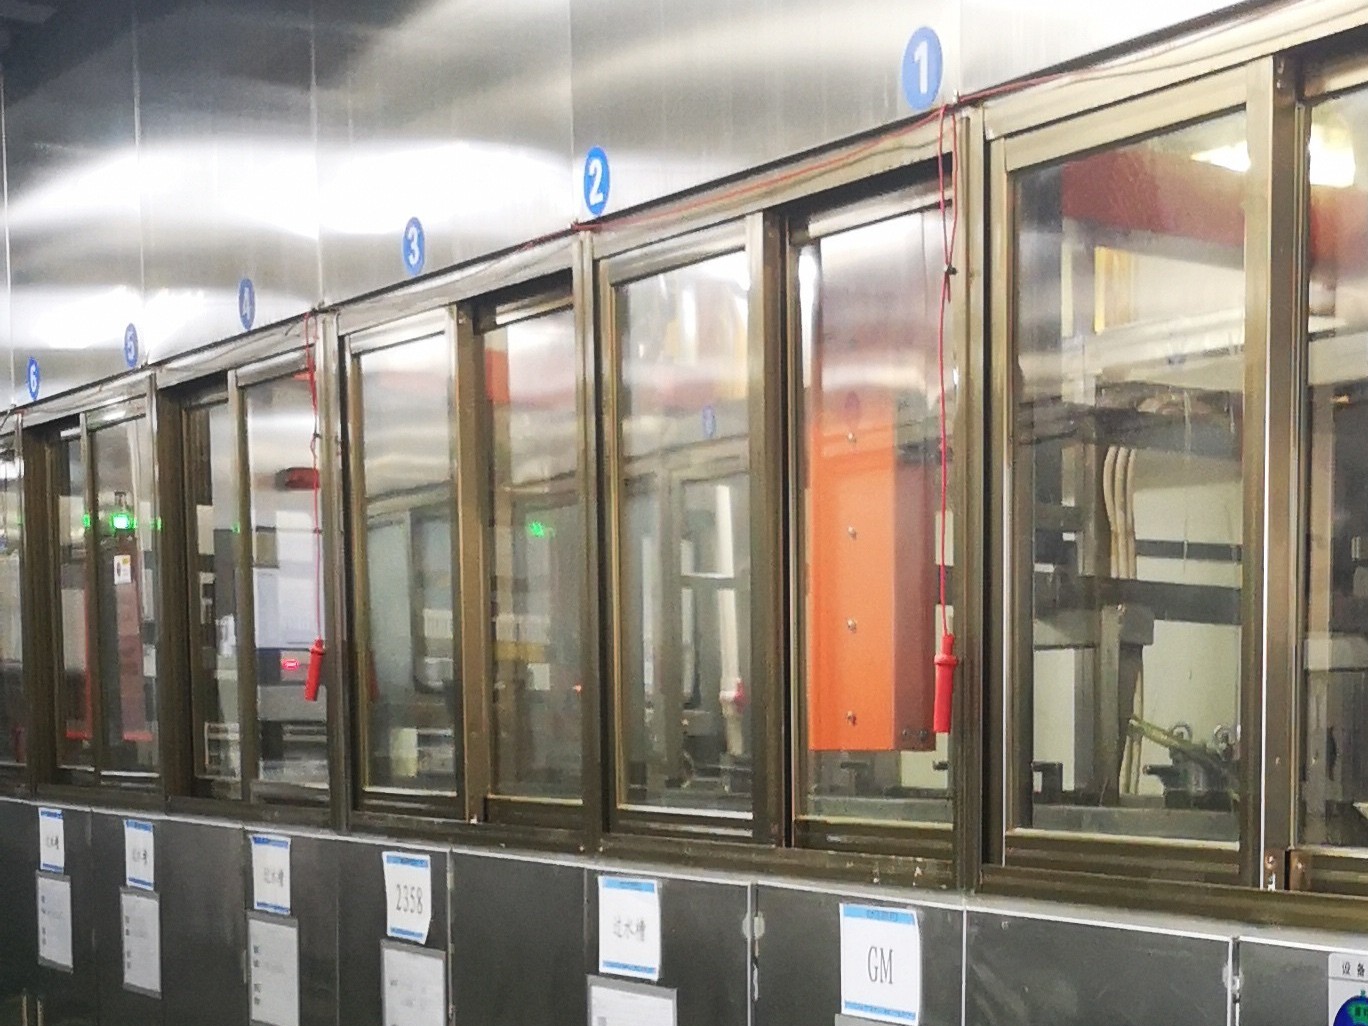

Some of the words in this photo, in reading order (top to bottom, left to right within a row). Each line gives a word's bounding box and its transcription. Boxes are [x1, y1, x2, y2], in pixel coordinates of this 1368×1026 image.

[914, 41, 928, 94] 1
[589, 159, 604, 206] 2
[408, 227, 420, 265] 3
[242, 287, 250, 320] 4
[867, 945, 894, 985] GM
